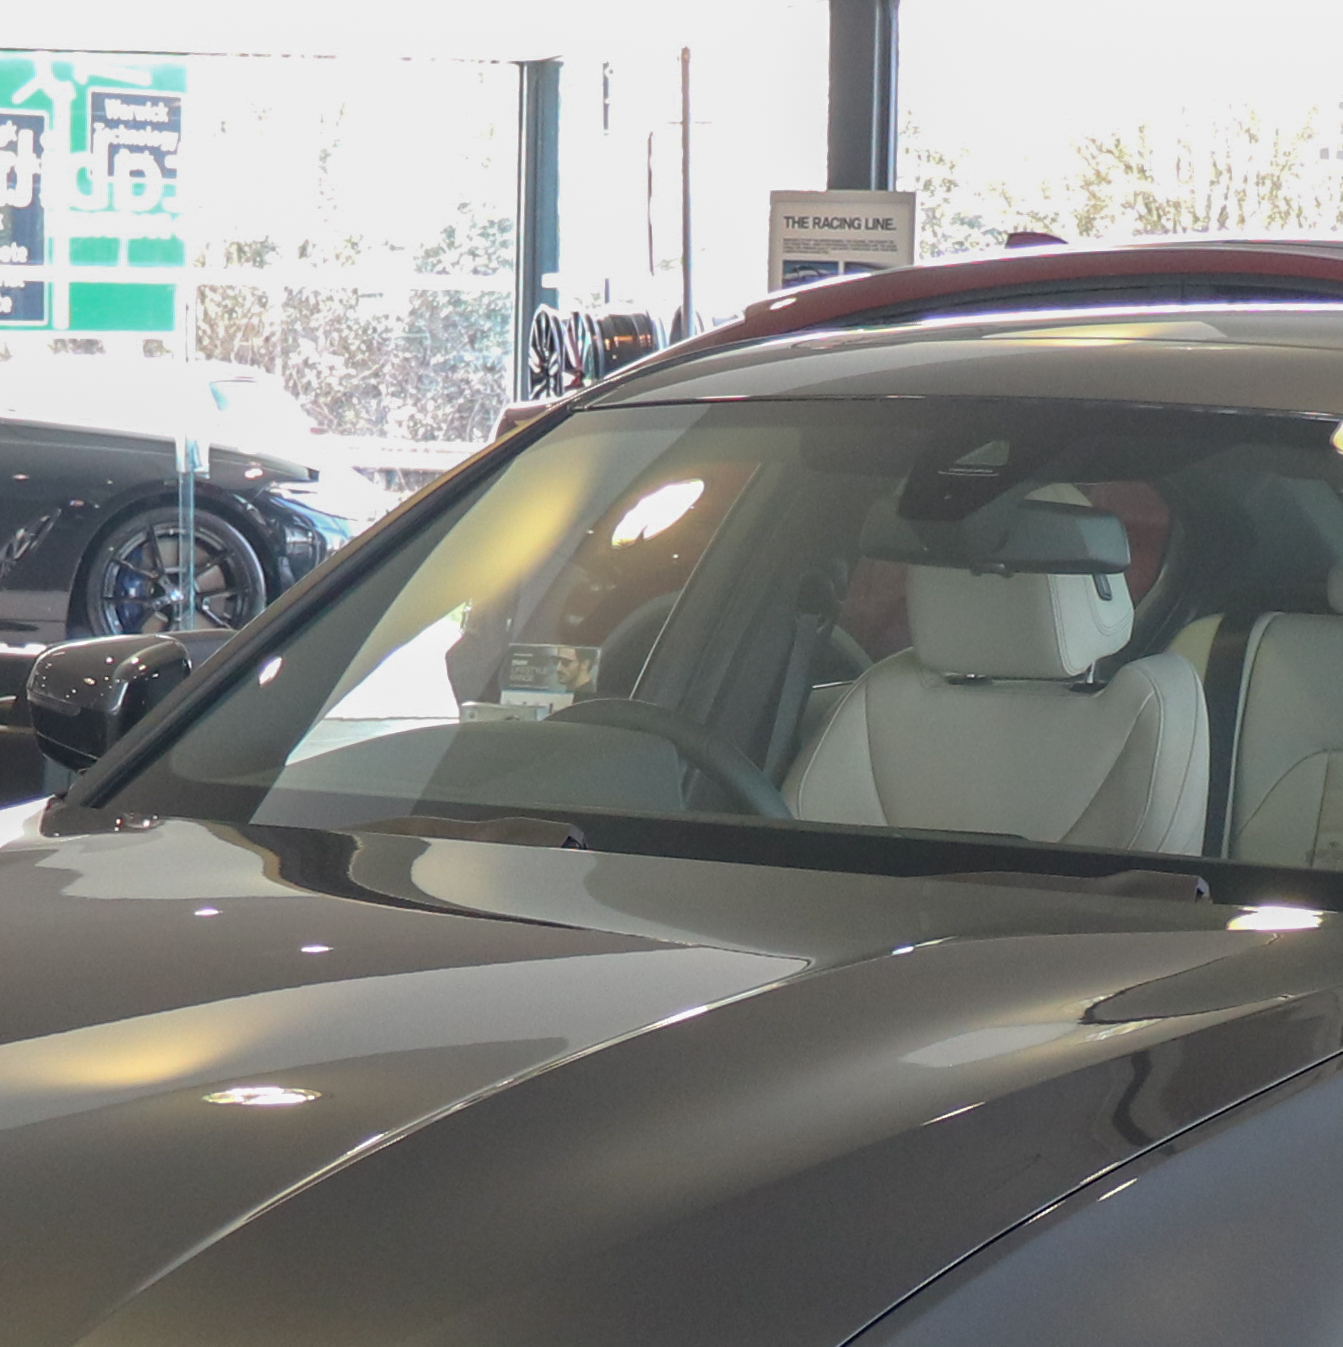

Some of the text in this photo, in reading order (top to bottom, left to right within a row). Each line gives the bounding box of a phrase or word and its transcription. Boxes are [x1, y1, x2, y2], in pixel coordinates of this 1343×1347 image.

[104, 98, 169, 123] Warwick
[783, 215, 897, 231] THE RACING LINE.
